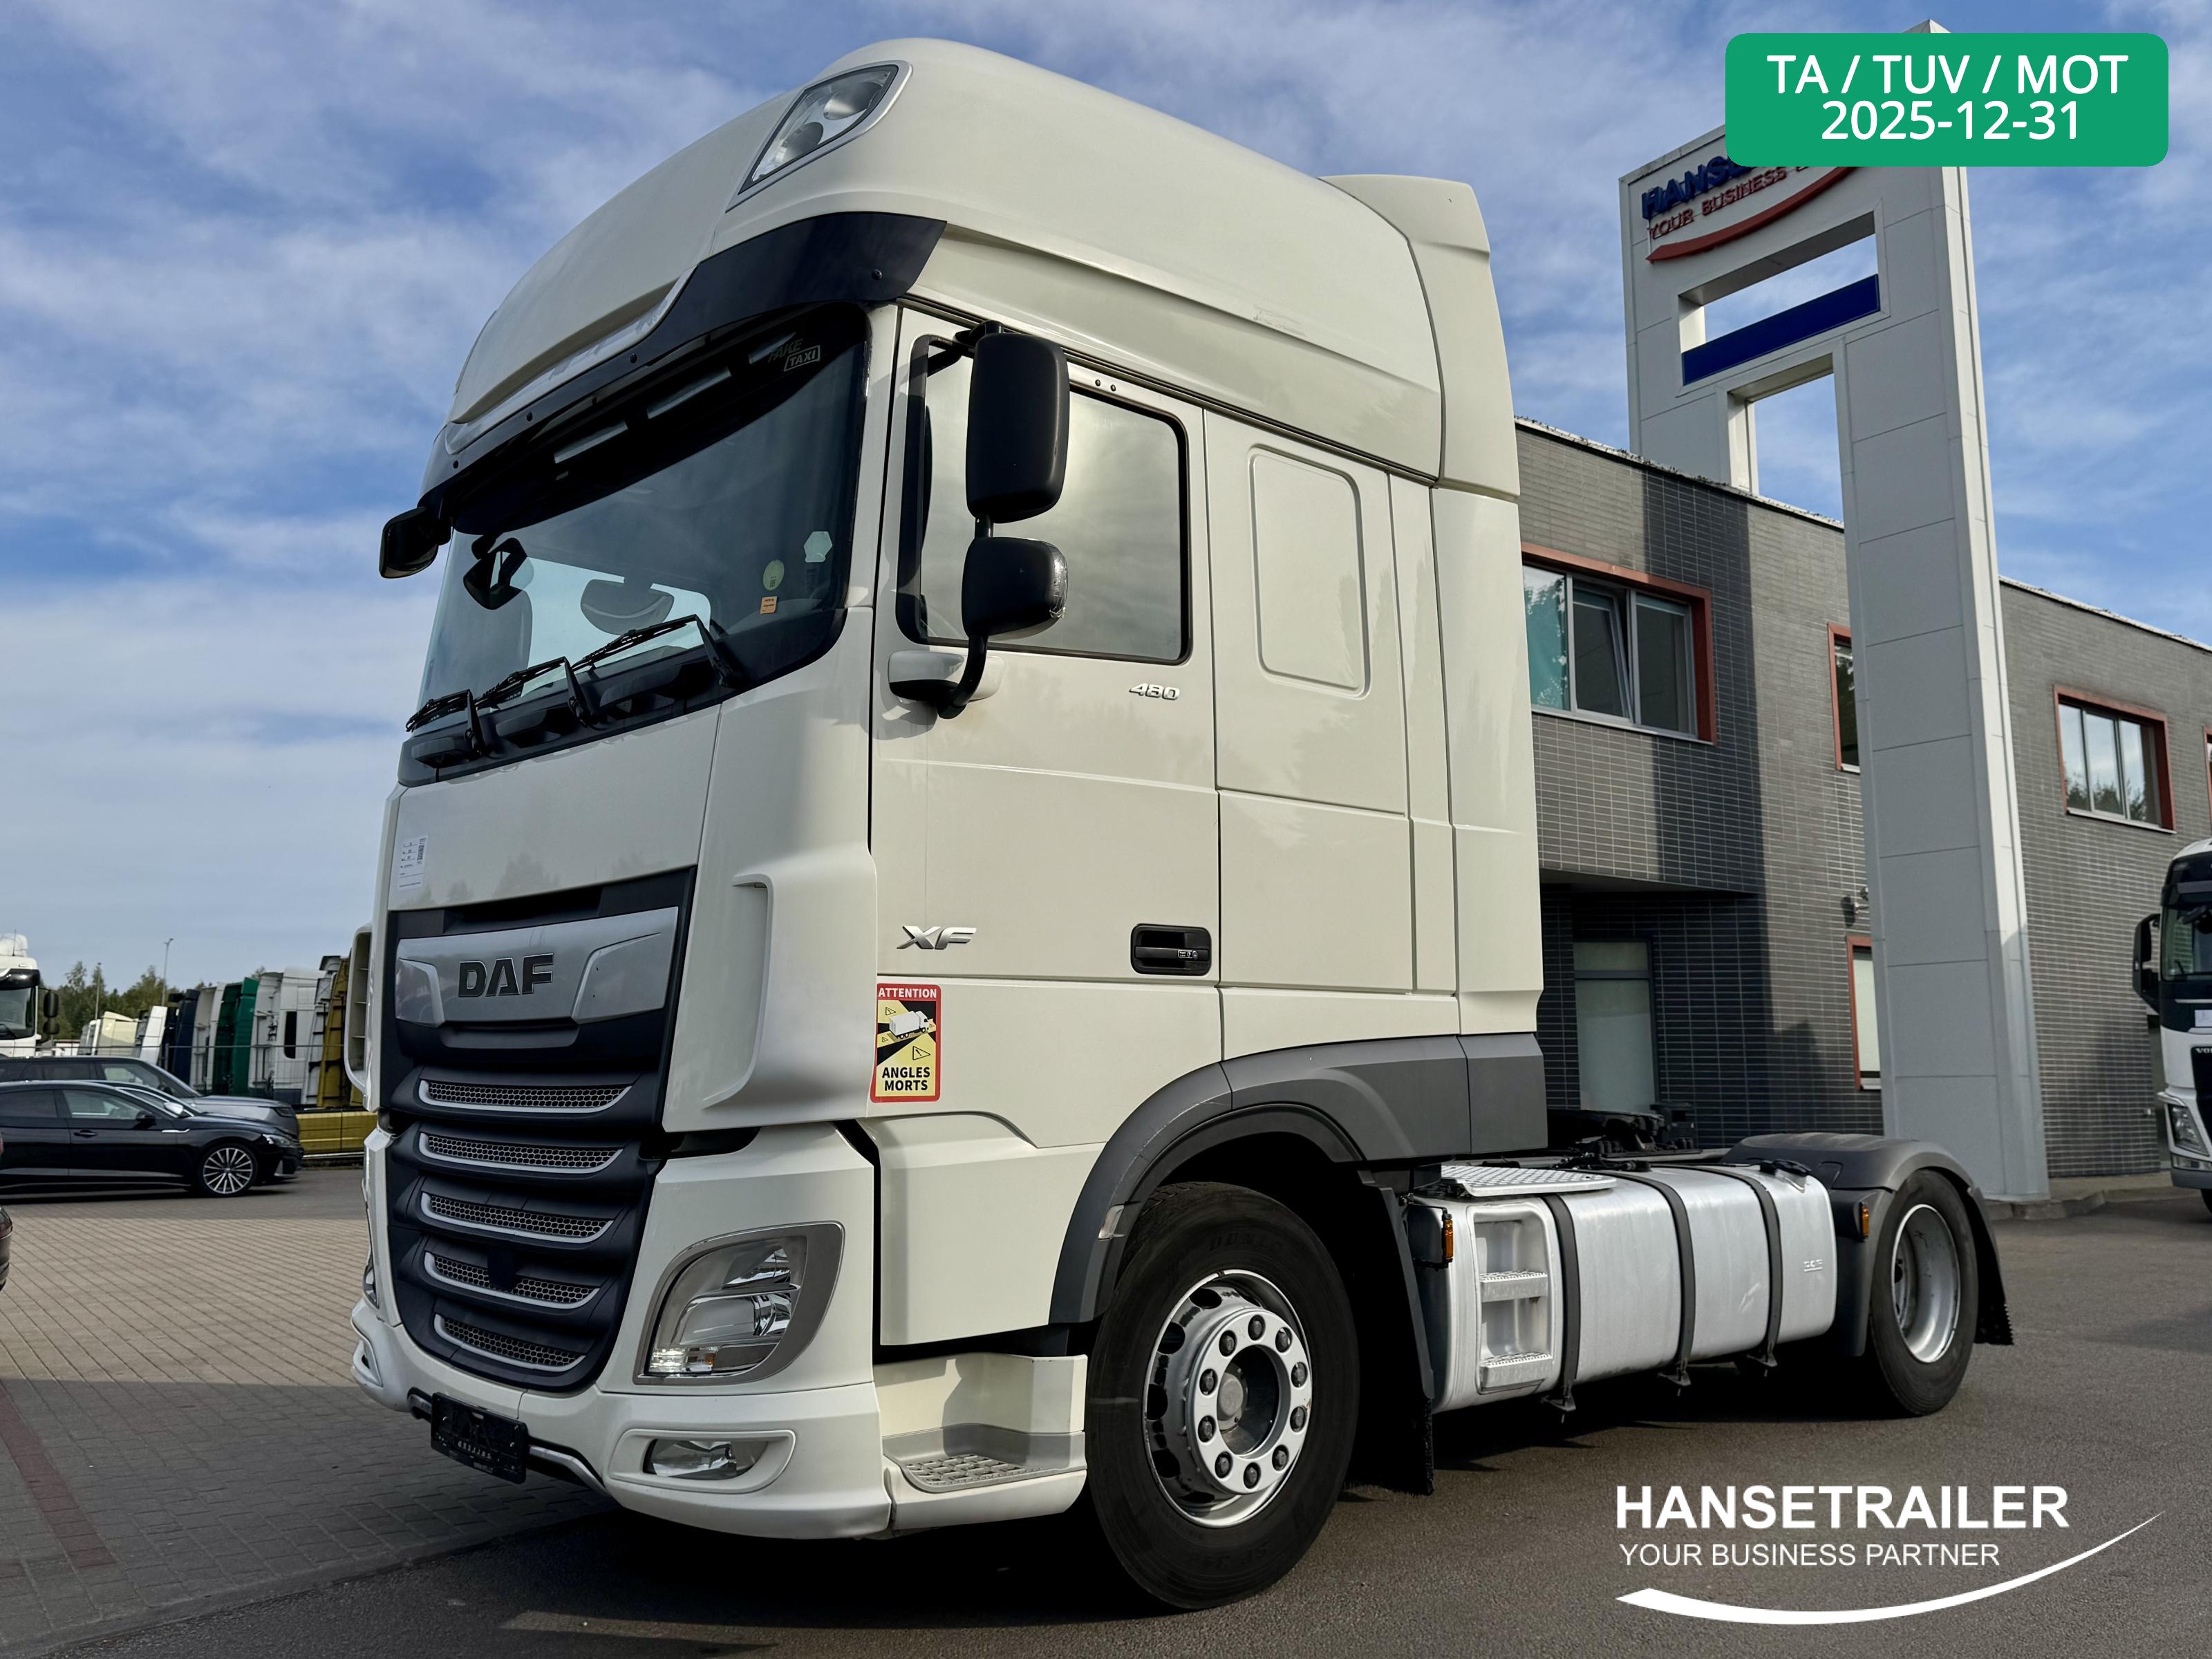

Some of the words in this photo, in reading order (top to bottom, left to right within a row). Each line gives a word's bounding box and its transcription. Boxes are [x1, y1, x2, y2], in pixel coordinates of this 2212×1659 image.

[1649, 209, 1694, 240] YOUR
[1701, 166, 1788, 216] BUSINESS
[789, 350, 816, 367] TAXI
[1129, 683, 1180, 700] 480
[897, 926, 977, 950] XF
[458, 953, 554, 997] DAF
[878, 988, 937, 998] ATTENTION
[882, 1067, 930, 1078] ANGLES
[884, 1080, 928, 1091] MORTS
